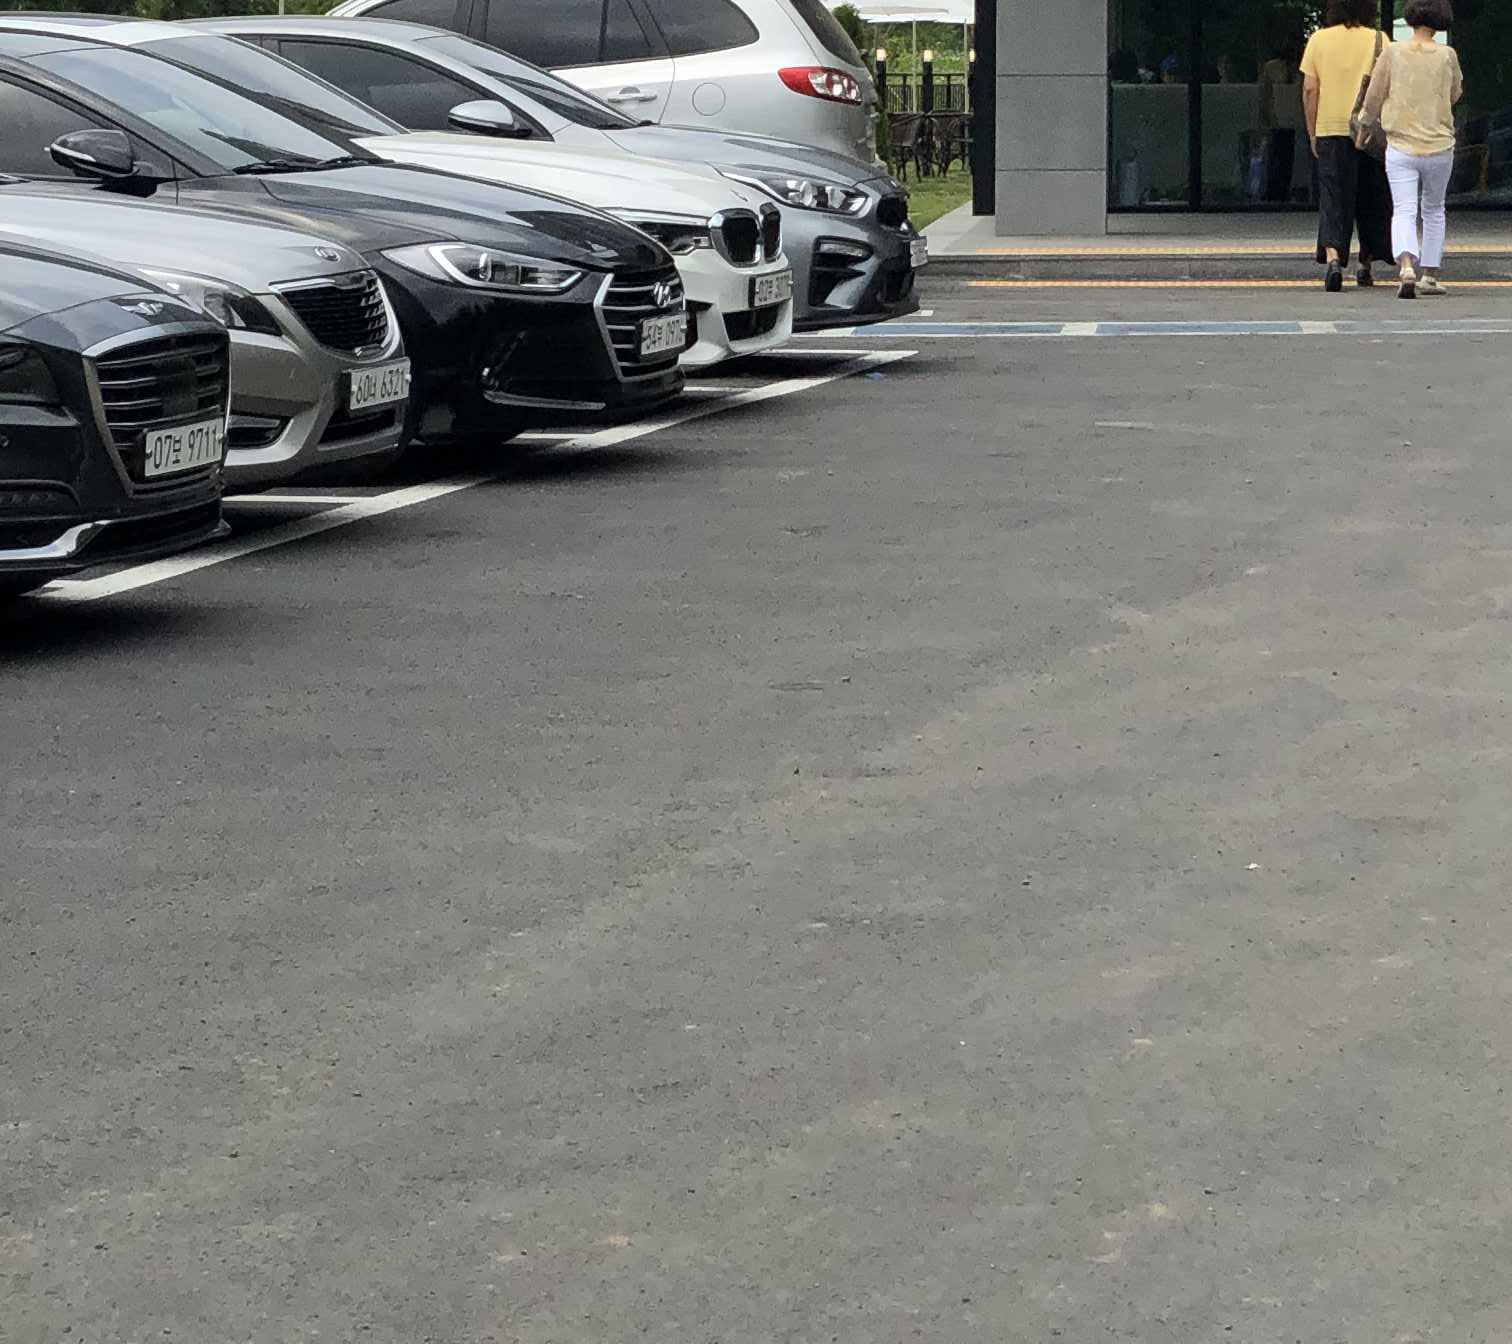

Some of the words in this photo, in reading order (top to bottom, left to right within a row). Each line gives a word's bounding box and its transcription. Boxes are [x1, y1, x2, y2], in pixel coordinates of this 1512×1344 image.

[666, 319, 682, 345] 097
[381, 368, 404, 398] 6321
[154, 435, 182, 469] 07보
[188, 425, 217, 462] 9711
